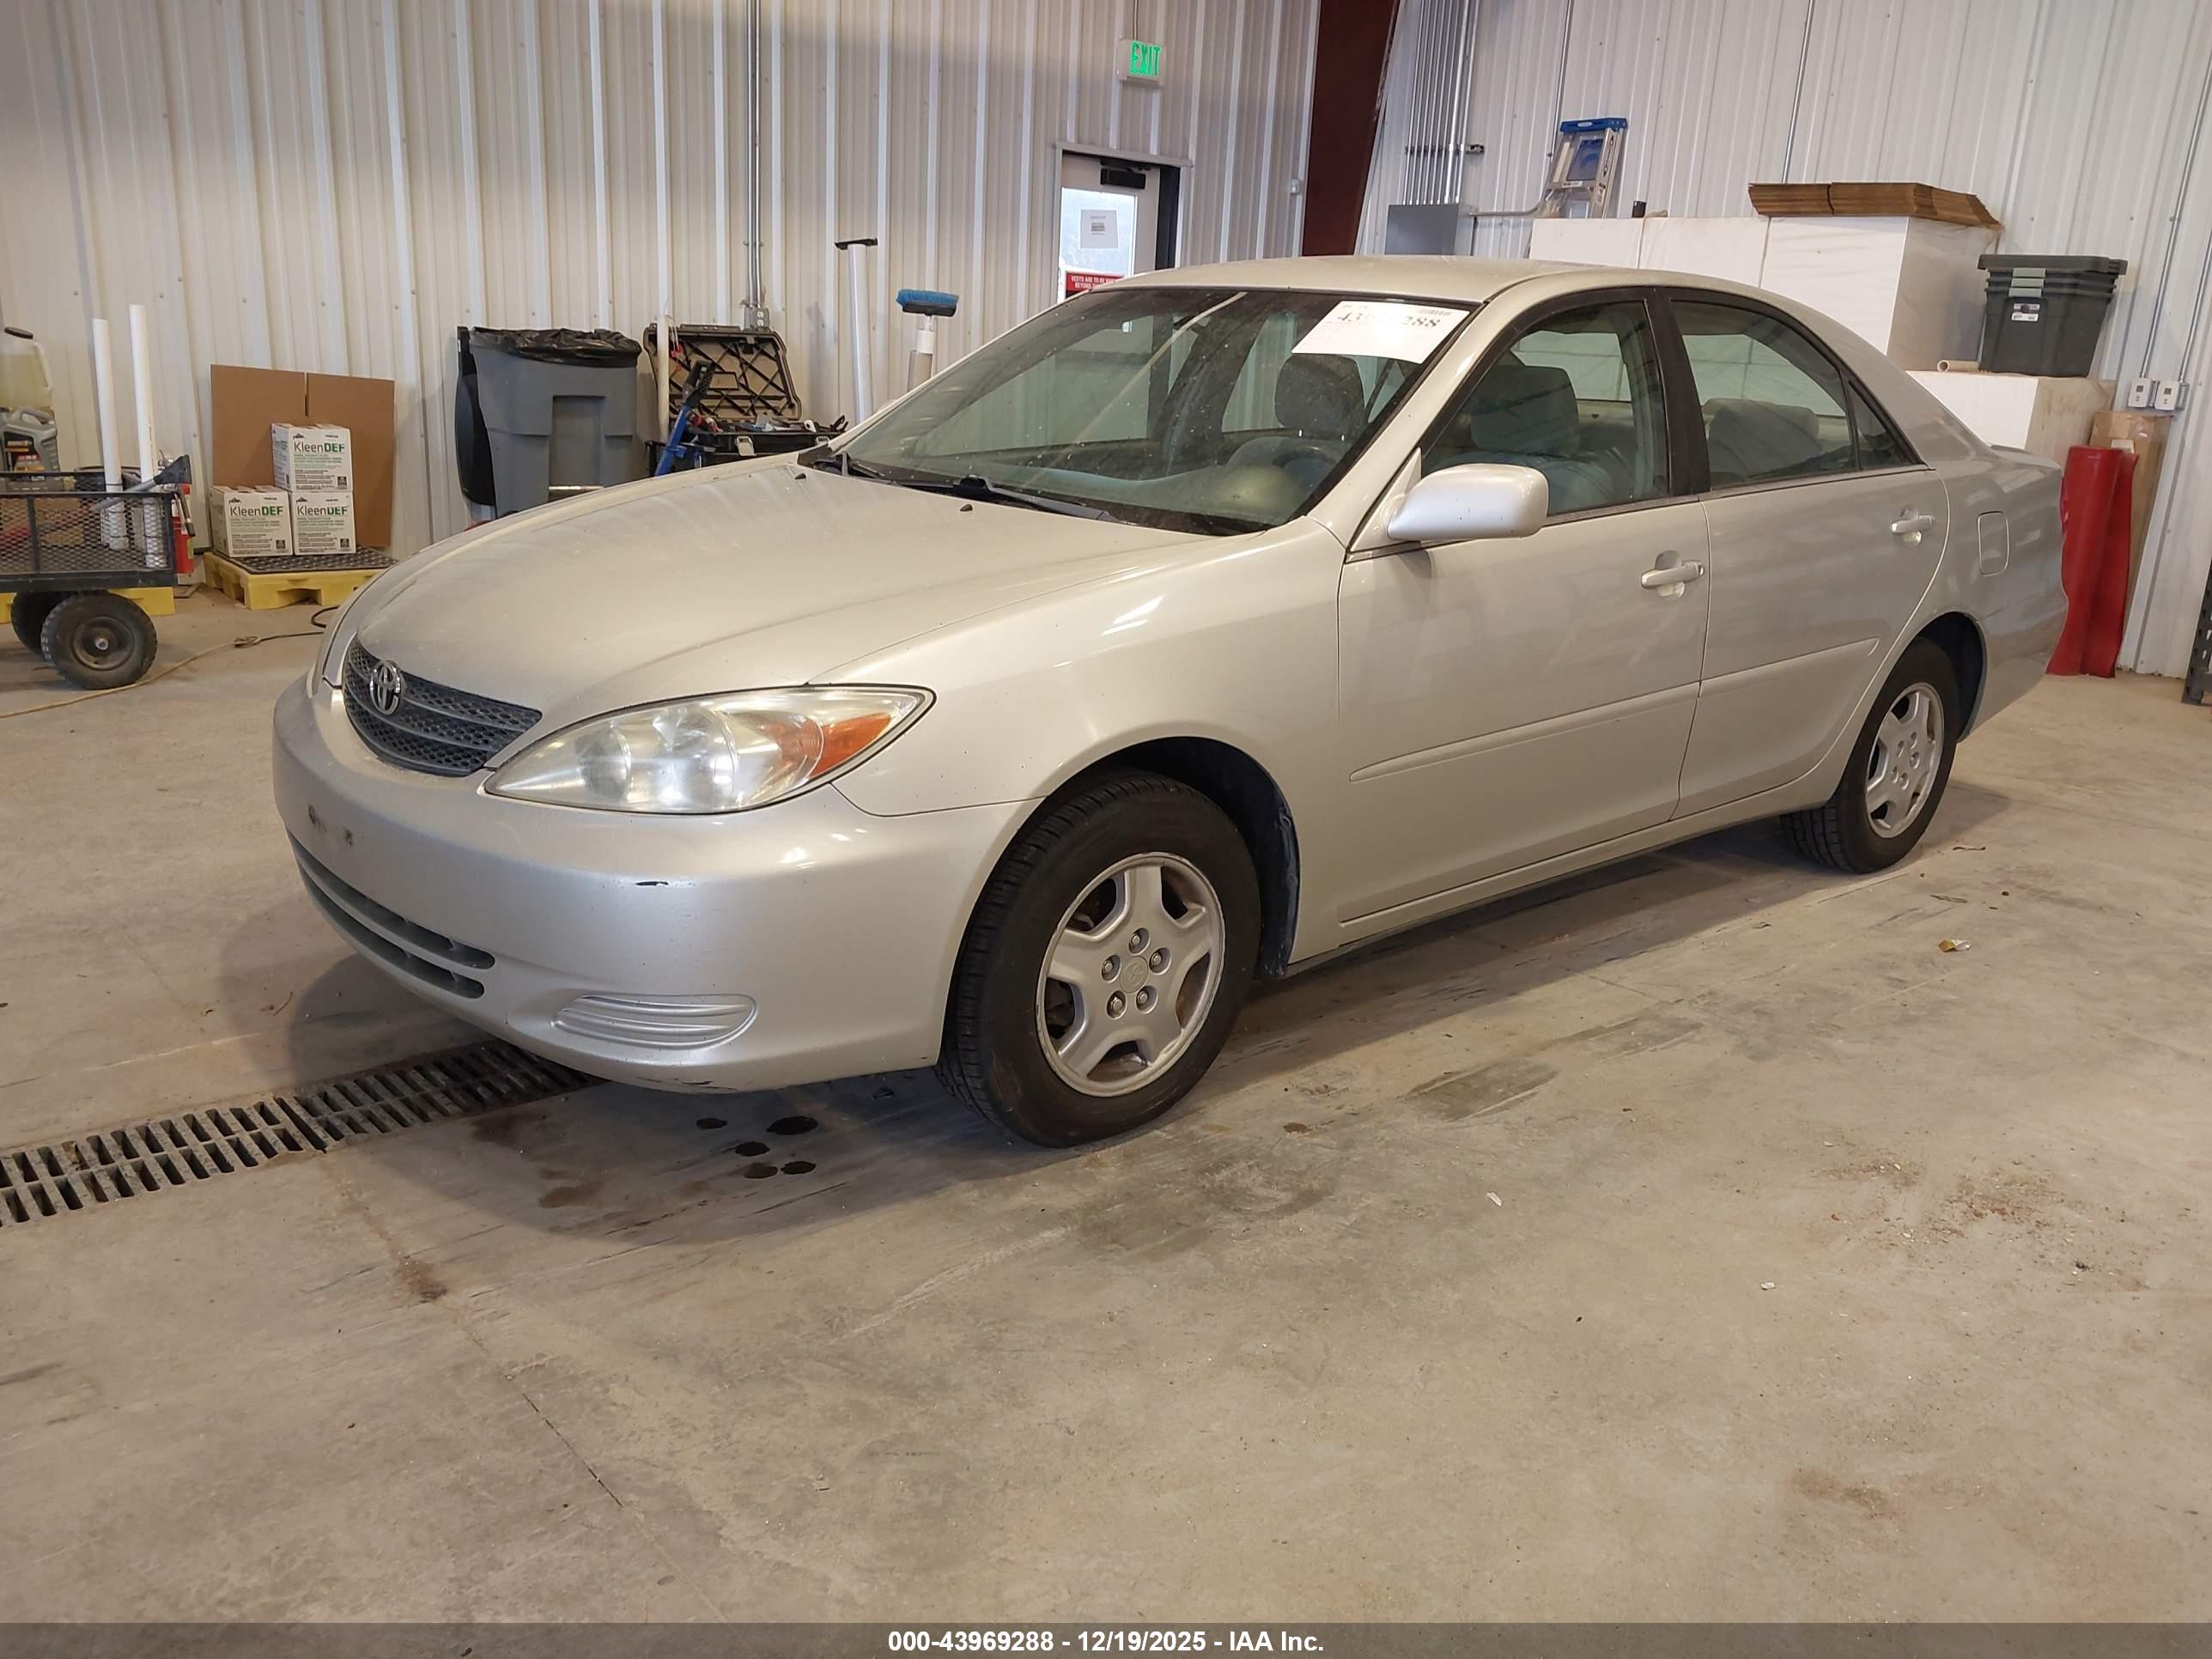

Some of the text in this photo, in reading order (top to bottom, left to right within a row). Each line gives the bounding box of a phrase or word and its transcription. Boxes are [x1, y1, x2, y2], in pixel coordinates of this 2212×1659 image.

[1131, 40, 1161, 76] EXIT
[294, 441, 345, 453] KleenDEF
[229, 505, 283, 516] KleenDEF
[297, 505, 349, 516] KleenDEF
